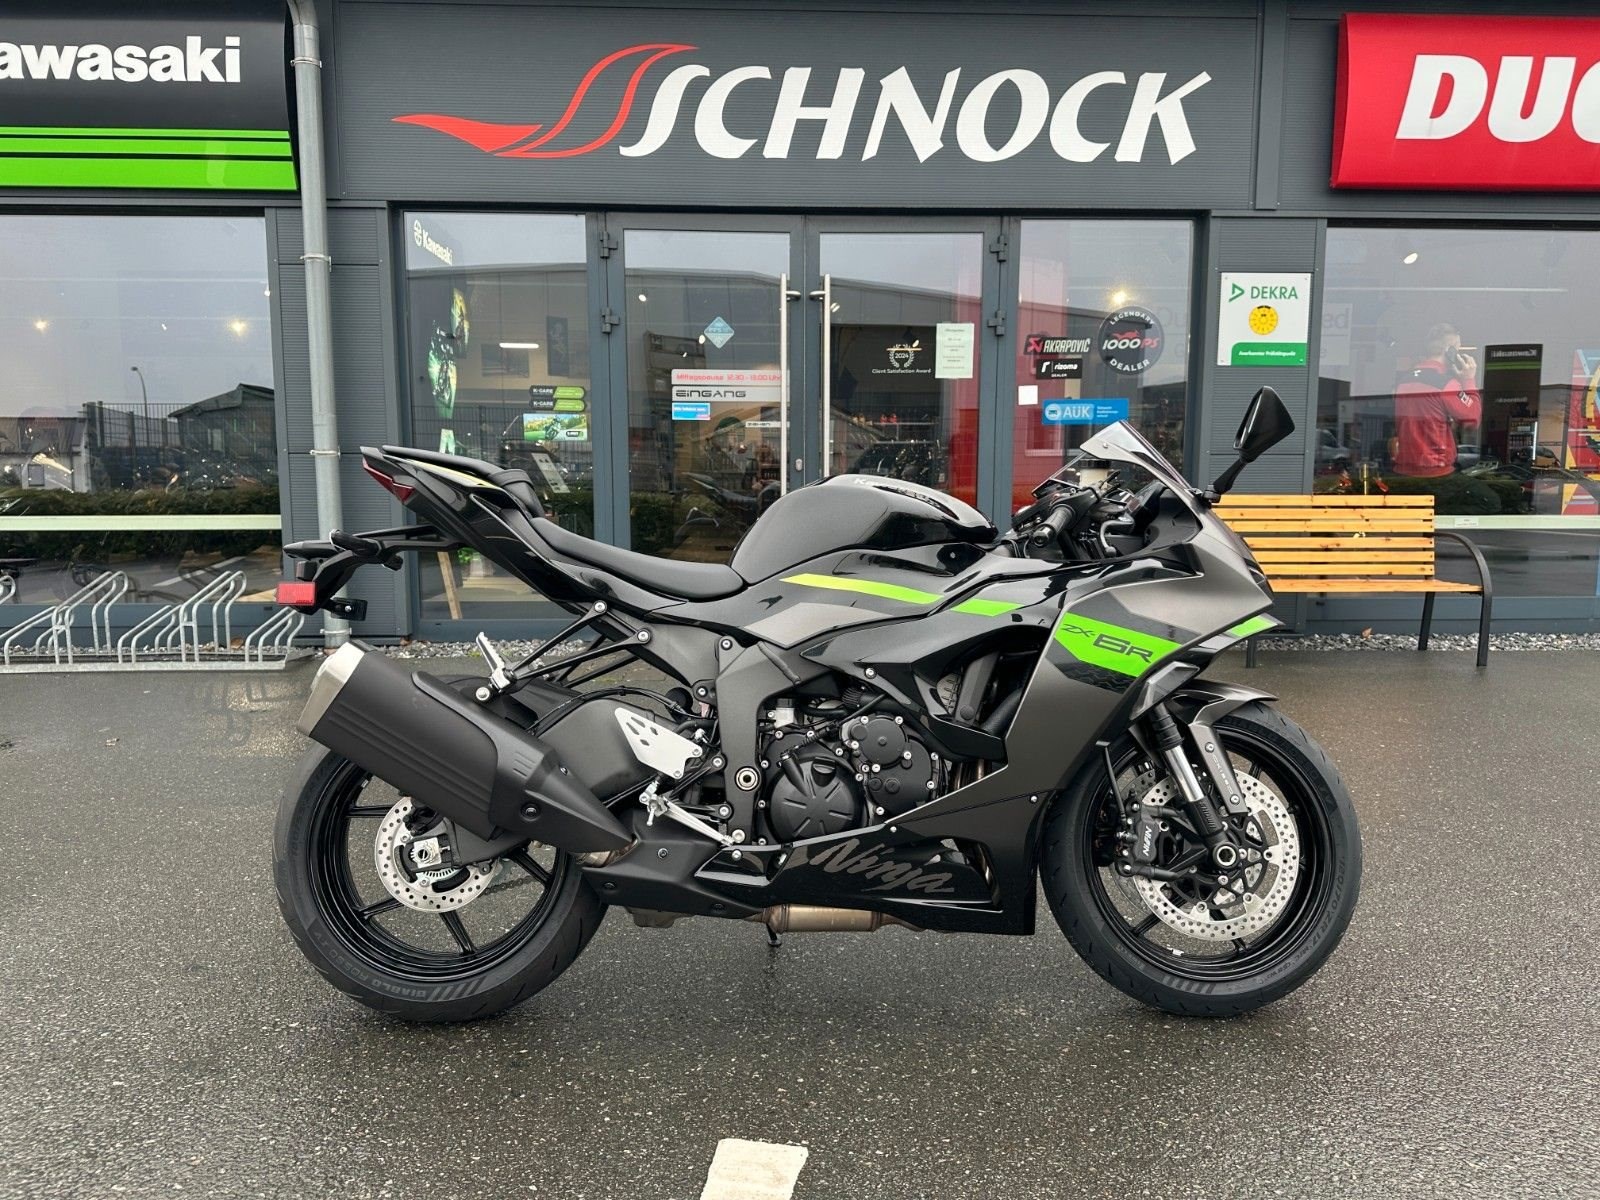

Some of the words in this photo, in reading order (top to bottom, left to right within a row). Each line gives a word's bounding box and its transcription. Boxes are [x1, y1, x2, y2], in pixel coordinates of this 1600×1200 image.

[620, 64, 1212, 165] SCHNOCK
[422, 229, 453, 266] Kawasaki
[1250, 286, 1298, 299] DEKRA
[1110, 311, 1155, 325] LEGENDARY
[1102, 338, 1159, 350] 1000PS
[1054, 362, 1078, 370] rizoma
[1110, 358, 1151, 372] DEALER
[1062, 405, 1091, 418] AUK
[808, 838, 955, 893] Ninja
[329, 949, 369, 981] ROSSO
[371, 980, 426, 998] DIABLO
